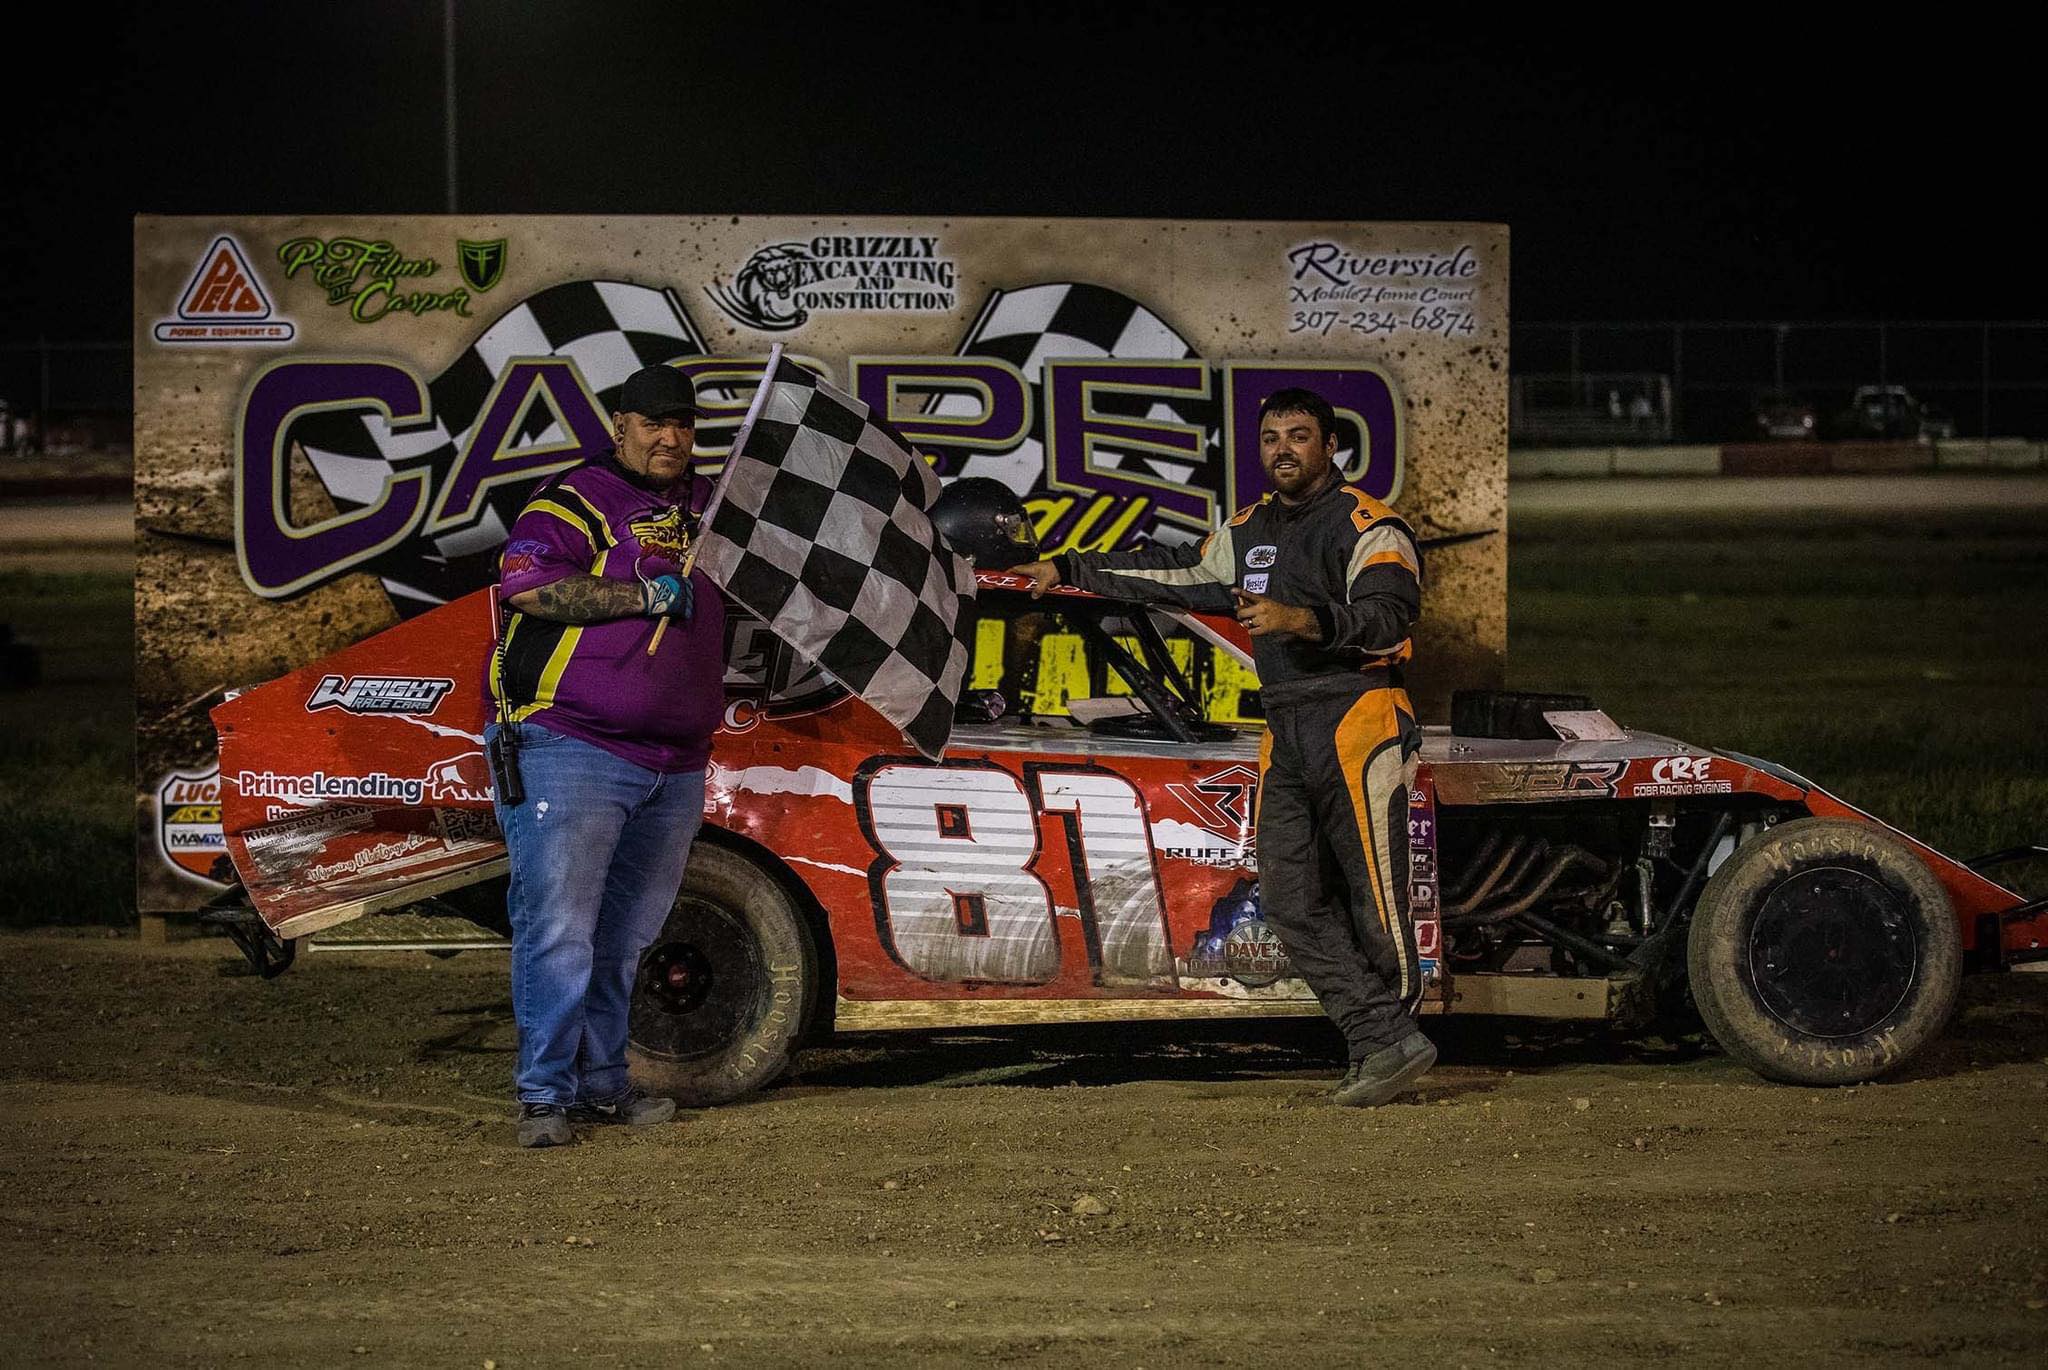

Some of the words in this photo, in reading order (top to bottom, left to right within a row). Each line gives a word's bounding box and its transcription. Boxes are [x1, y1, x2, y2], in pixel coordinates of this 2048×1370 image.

[810, 236, 939, 258] GRIZZLY
[793, 260, 954, 289] EXCAVATING
[1287, 243, 1477, 287] Riverside
[855, 277, 895, 291] AND
[1289, 286, 1357, 303] Mobile
[1357, 288, 1418, 304] Home
[1420, 287, 1473, 304] Court
[351, 277, 473, 323] Casper
[793, 292, 951, 310] CONSTRUCTION
[169, 328, 208, 337] POWER
[211, 328, 265, 337] EQUIPMENT
[1289, 306, 1475, 338] 307-234-6874
[309, 678, 450, 708] WRIGHT
[352, 697, 392, 711] RACE
[392, 700, 431, 711] CARS
[1651, 757, 1712, 784] CRE
[239, 772, 425, 805] PrimeLending
[1659, 784, 1693, 796] RACING
[1694, 783, 1732, 794] ENGINES
[244, 816, 325, 842] KIMBERLY
[1165, 847, 1236, 859] RUFF
[1224, 942, 1289, 958] DAVE'S
